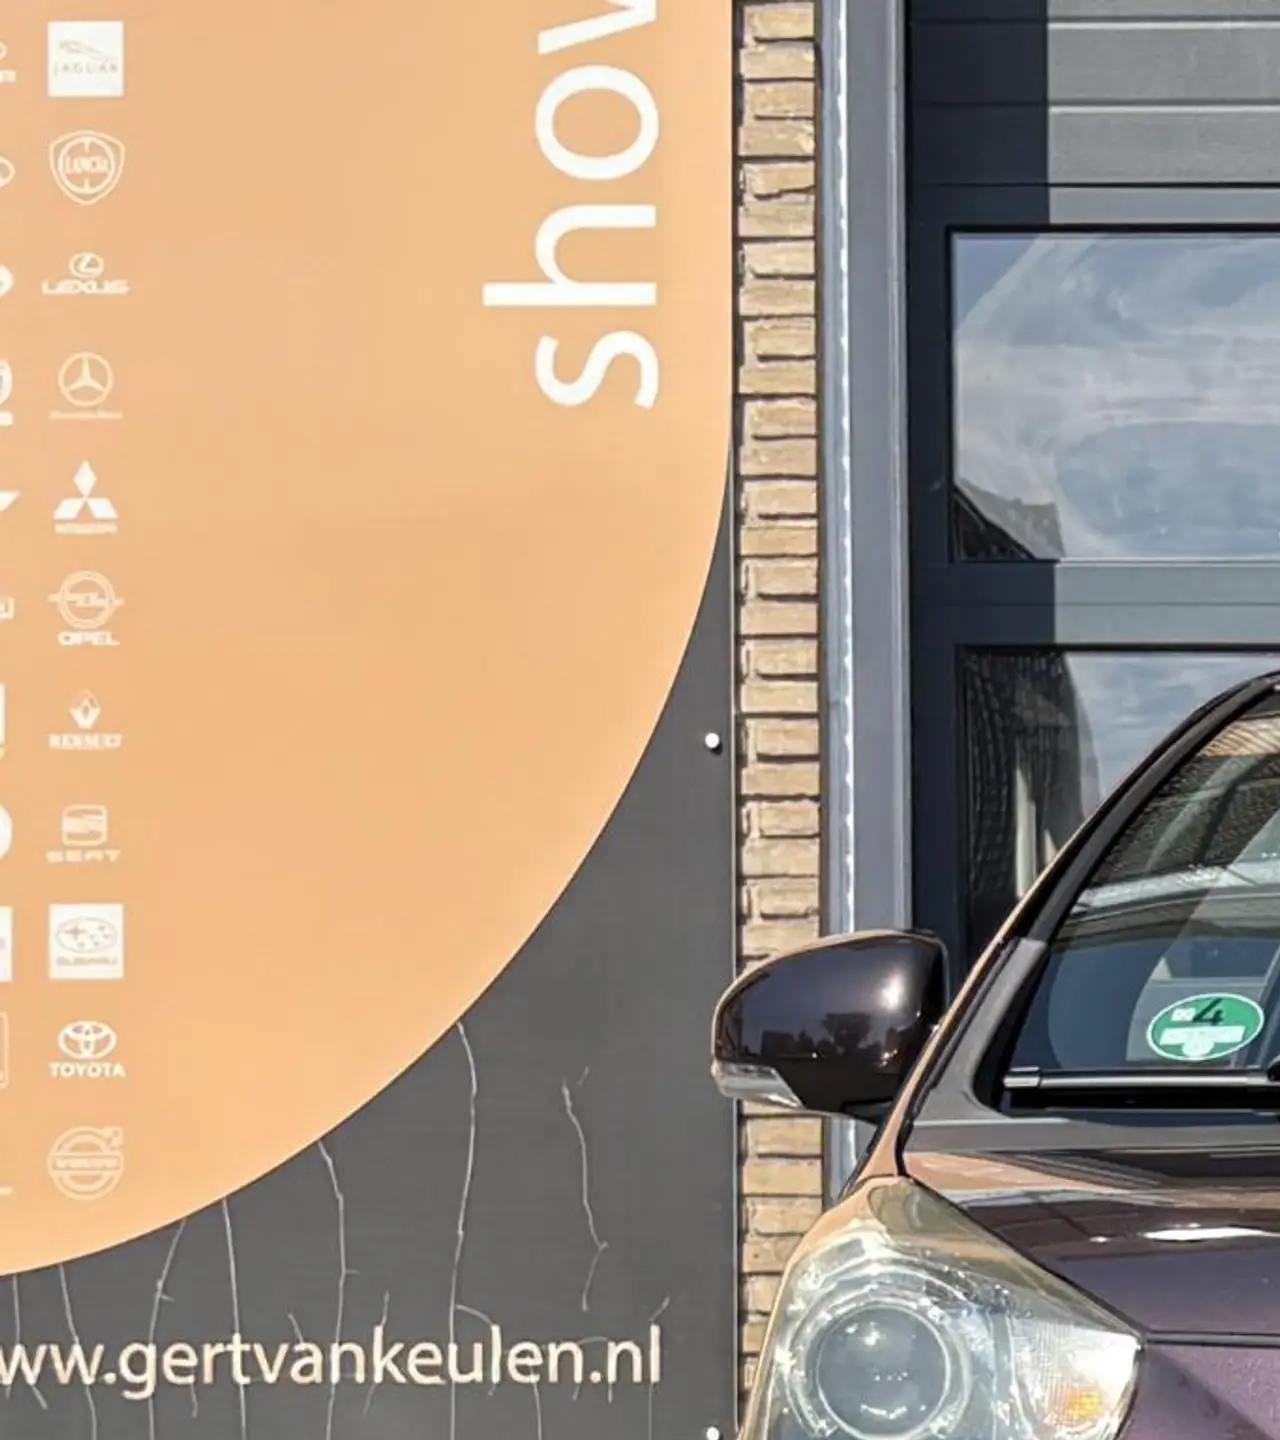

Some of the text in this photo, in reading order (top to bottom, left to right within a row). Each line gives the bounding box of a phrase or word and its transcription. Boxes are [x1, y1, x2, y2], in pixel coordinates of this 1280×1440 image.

[53, 62, 119, 76] JAGUAR
[1191, 998, 1224, 1027] 4
[49, 1062, 126, 1078] TOYOTA
